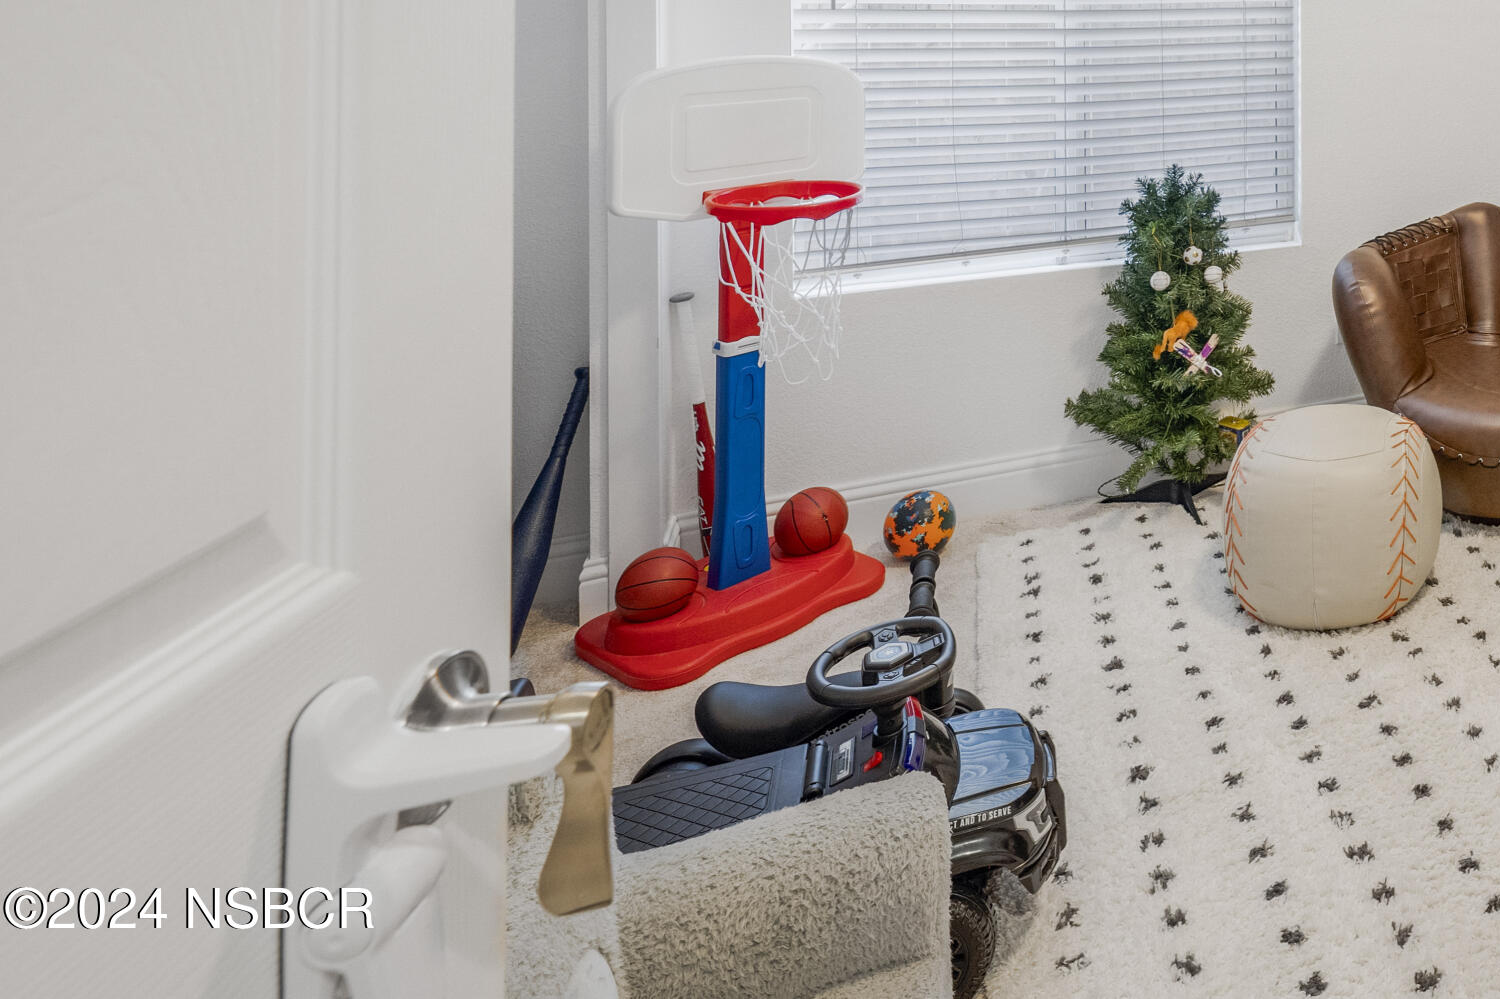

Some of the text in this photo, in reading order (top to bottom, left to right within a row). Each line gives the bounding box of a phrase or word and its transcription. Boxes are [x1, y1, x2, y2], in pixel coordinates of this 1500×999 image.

[959, 815, 976, 827] AND
[977, 813, 987, 823] TO
[988, 805, 1012, 820] SERVE
